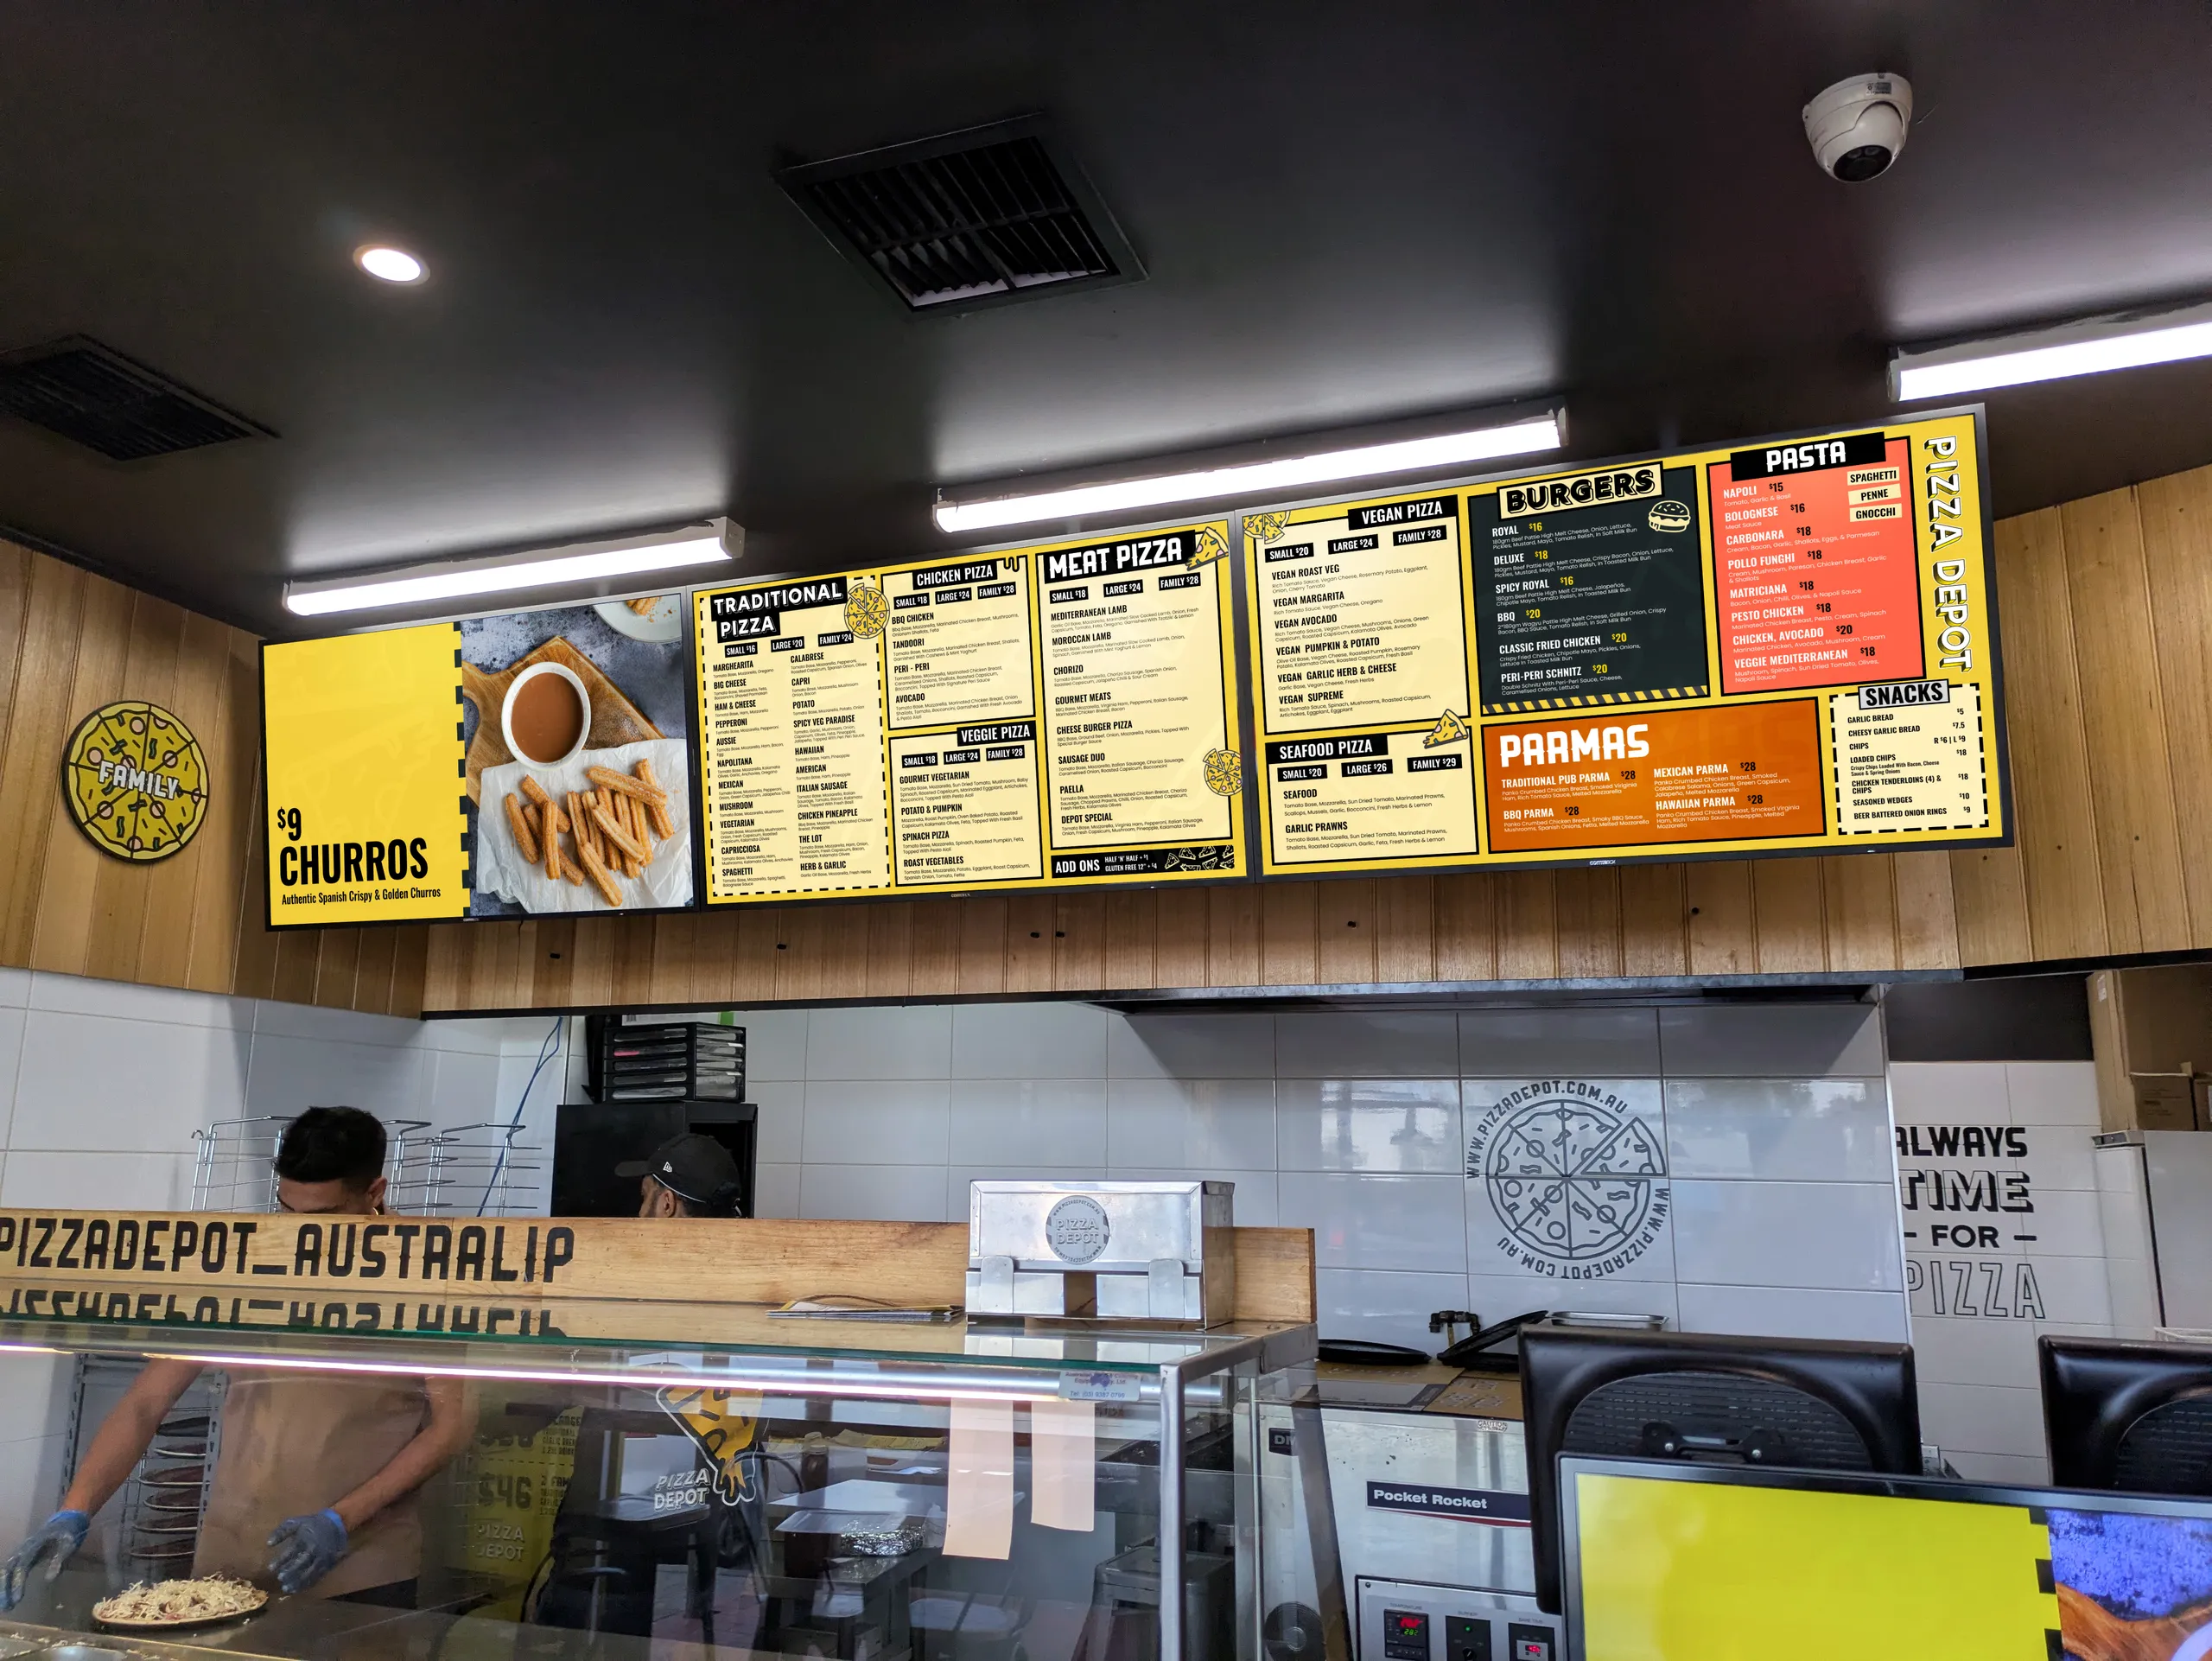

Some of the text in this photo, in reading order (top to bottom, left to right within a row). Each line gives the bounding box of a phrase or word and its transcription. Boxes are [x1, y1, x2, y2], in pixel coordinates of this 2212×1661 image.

[1766, 441, 1847, 473] PASTA
[1850, 470, 1897, 483] SPAGHETTI
[1506, 469, 1656, 514] BURGERS
[1724, 482, 1783, 499] NAPOLI $15
[1861, 488, 1888, 501] PENNE
[1362, 501, 1443, 525] VEGAN PIZZA
[1725, 503, 1805, 522] BOLOGNESE $16
[1856, 507, 1896, 519] GNOCCHI
[1492, 522, 1542, 537] ROYAL $16
[1726, 526, 1811, 546] CARBONARA $18
[1049, 538, 1182, 579] MEAT PIZZA
[1494, 550, 1548, 565] DELUXE $18
[1924, 435, 1973, 672] PIZZA DEPOT
[917, 564, 993, 586] CHICKEN PIZZA
[1160, 576, 1198, 589] FAMILY $28
[1052, 589, 1086, 601] SMALL $18
[1105, 582, 1141, 595] LARGE $24
[1730, 581, 1814, 600] MATRICIANA $18
[713, 582, 843, 615] TRADITIONAL
[1273, 591, 1344, 608] VEGAN MARGARITA
[892, 612, 934, 625] BBQ CHICKEN
[1051, 605, 1128, 621] MEDITERRANEAN LAMB
[1497, 608, 1541, 622] BBQ $20
[720, 615, 777, 639] PIZZA
[1274, 614, 1337, 629] VEGAN AVOCADO
[772, 640, 791, 650] LARGE
[819, 633, 852, 645] FAMILY $24
[727, 646, 745, 656] SMALL
[791, 652, 824, 663] CALABRESE
[713, 660, 753, 671] MARGHEARITA
[1053, 665, 1084, 676] CHORIZO
[1501, 664, 1607, 683] PERI-PERI SCHNITZ $20
[714, 678, 747, 690] BIG CHEESE
[895, 693, 925, 703] AVOCADO
[1866, 682, 1943, 707] SNACKS
[715, 718, 747, 729] PEPPERONI
[961, 724, 1030, 742] VEGGIE PIZZA
[795, 745, 824, 755] HAWAIIAN
[1280, 739, 1373, 760] SEAFOOD PIZZA
[1500, 724, 1649, 767] PARMAS
[717, 757, 753, 767] NAPOLITANA
[796, 764, 826, 773] AMERICAN
[1654, 761, 1756, 778] MEXICAN PARMA $28
[99, 760, 180, 800] FAMILY
[718, 780, 743, 789] MEXICAN
[899, 771, 969, 784] GOURMET VEGETARIAN
[1501, 770, 1636, 788] TRADITIONAL PUB PARMA $28
[1059, 785, 1084, 794] PAELLA
[1283, 789, 1317, 799] SEAFOOD
[1853, 798, 1885, 806] SEASONED
[1061, 812, 1113, 824] DEPOT SPECIAL
[1503, 806, 1580, 820] BBQ PARMA $28
[277, 806, 302, 841] $9
[280, 837, 428, 886] CHURROS
[1056, 859, 1100, 873] ADD ONS
[722, 868, 753, 876] SPAGHETTI
[282, 887, 441, 905] Authentic Spanish Crispy & Golden Churros
[1895, 1126, 2028, 1157] ALWAYS
[1899, 1169, 2034, 1212] TIME
[1055, 1218, 1099, 1231] PIZZA
[1056, 1231, 1099, 1244] DEPOT
[1931, 1225, 1999, 1248] FOR
[1906, 1260, 2046, 1319] PIZZA
[655, 1467, 712, 1492] PIZZA
[653, 1487, 710, 1512] DEPOT
[1374, 1489, 1487, 1509] Pocket Rocket
